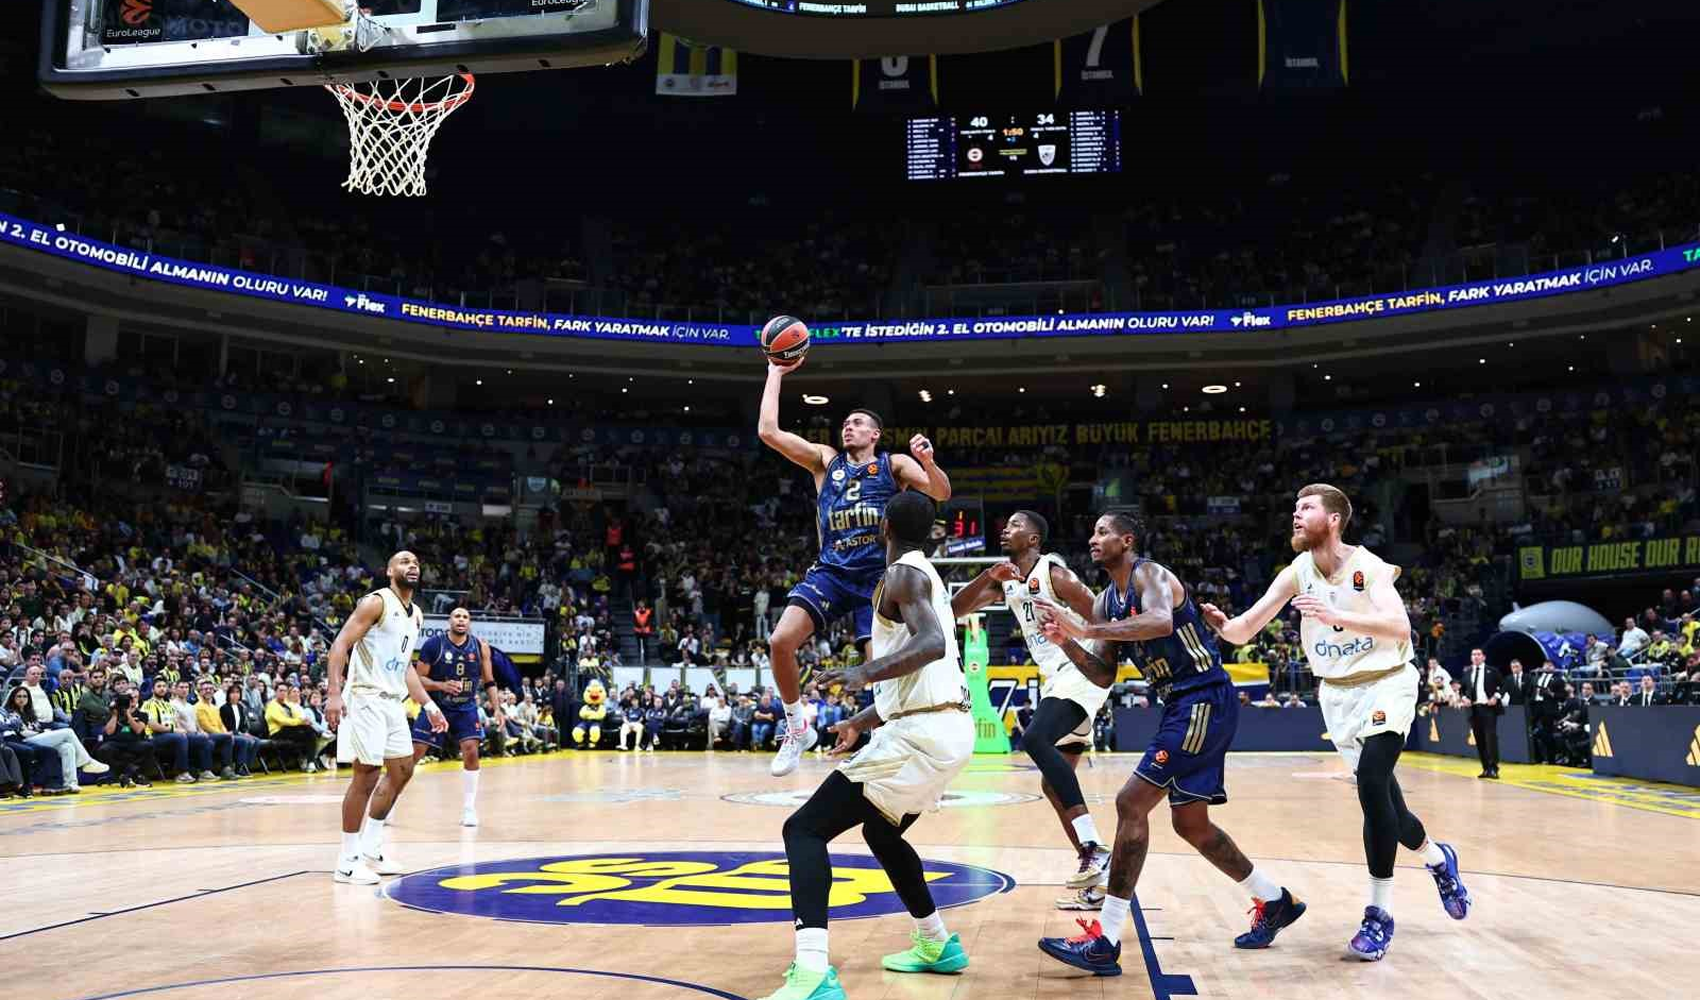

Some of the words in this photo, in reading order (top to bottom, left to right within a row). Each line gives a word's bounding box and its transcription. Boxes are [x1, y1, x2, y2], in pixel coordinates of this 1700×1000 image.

[106, 28, 160, 38] EuroLeague
[970, 116, 989, 128] 40
[1037, 114, 1055, 125] 34
[11, 224, 25, 238] 2.
[30, 230, 50, 245] EL
[56, 237, 148, 270] OTOMOBİLİ
[150, 262, 229, 285] ALMANIN
[233, 276, 288, 294] OLURU
[293, 286, 327, 301] VAR!
[1288, 300, 1384, 320] FENERBAHÇE
[1387, 291, 1445, 308] TARFİN,
[1449, 287, 1489, 301] FARK
[1494, 273, 1581, 296] YARATMAK
[1585, 267, 1616, 283] İÇİN
[1621, 260, 1653, 275] VAR.
[356, 294, 384, 312] Flex
[402, 304, 493, 327] FENERBAHÇE
[498, 315, 550, 330] TARFİN,
[554, 320, 591, 331] FARK
[595, 322, 670, 336] YARATMAK
[703, 329, 728, 338] VAR.
[865, 322, 934, 336] İSTEDİĞİN
[937, 324, 949, 334] 2.
[953, 324, 969, 334] EL
[974, 318, 1054, 333] OTOMOBİLİ
[1057, 318, 1124, 330] ALMANIN
[1128, 317, 1177, 328] OLURU
[1182, 316, 1214, 326] VAR!
[1243, 312, 1270, 326] Flex
[846, 479, 862, 501] 2
[828, 502, 879, 532] tarfin
[1551, 547, 1583, 575] OUR
[1588, 541, 1641, 572] HOUSE
[1645, 538, 1680, 568] OUR
[1022, 601, 1035, 622] 21
[401, 635, 408, 653] 0
[1315, 635, 1374, 657] dnata
[456, 663, 465, 676] 8
